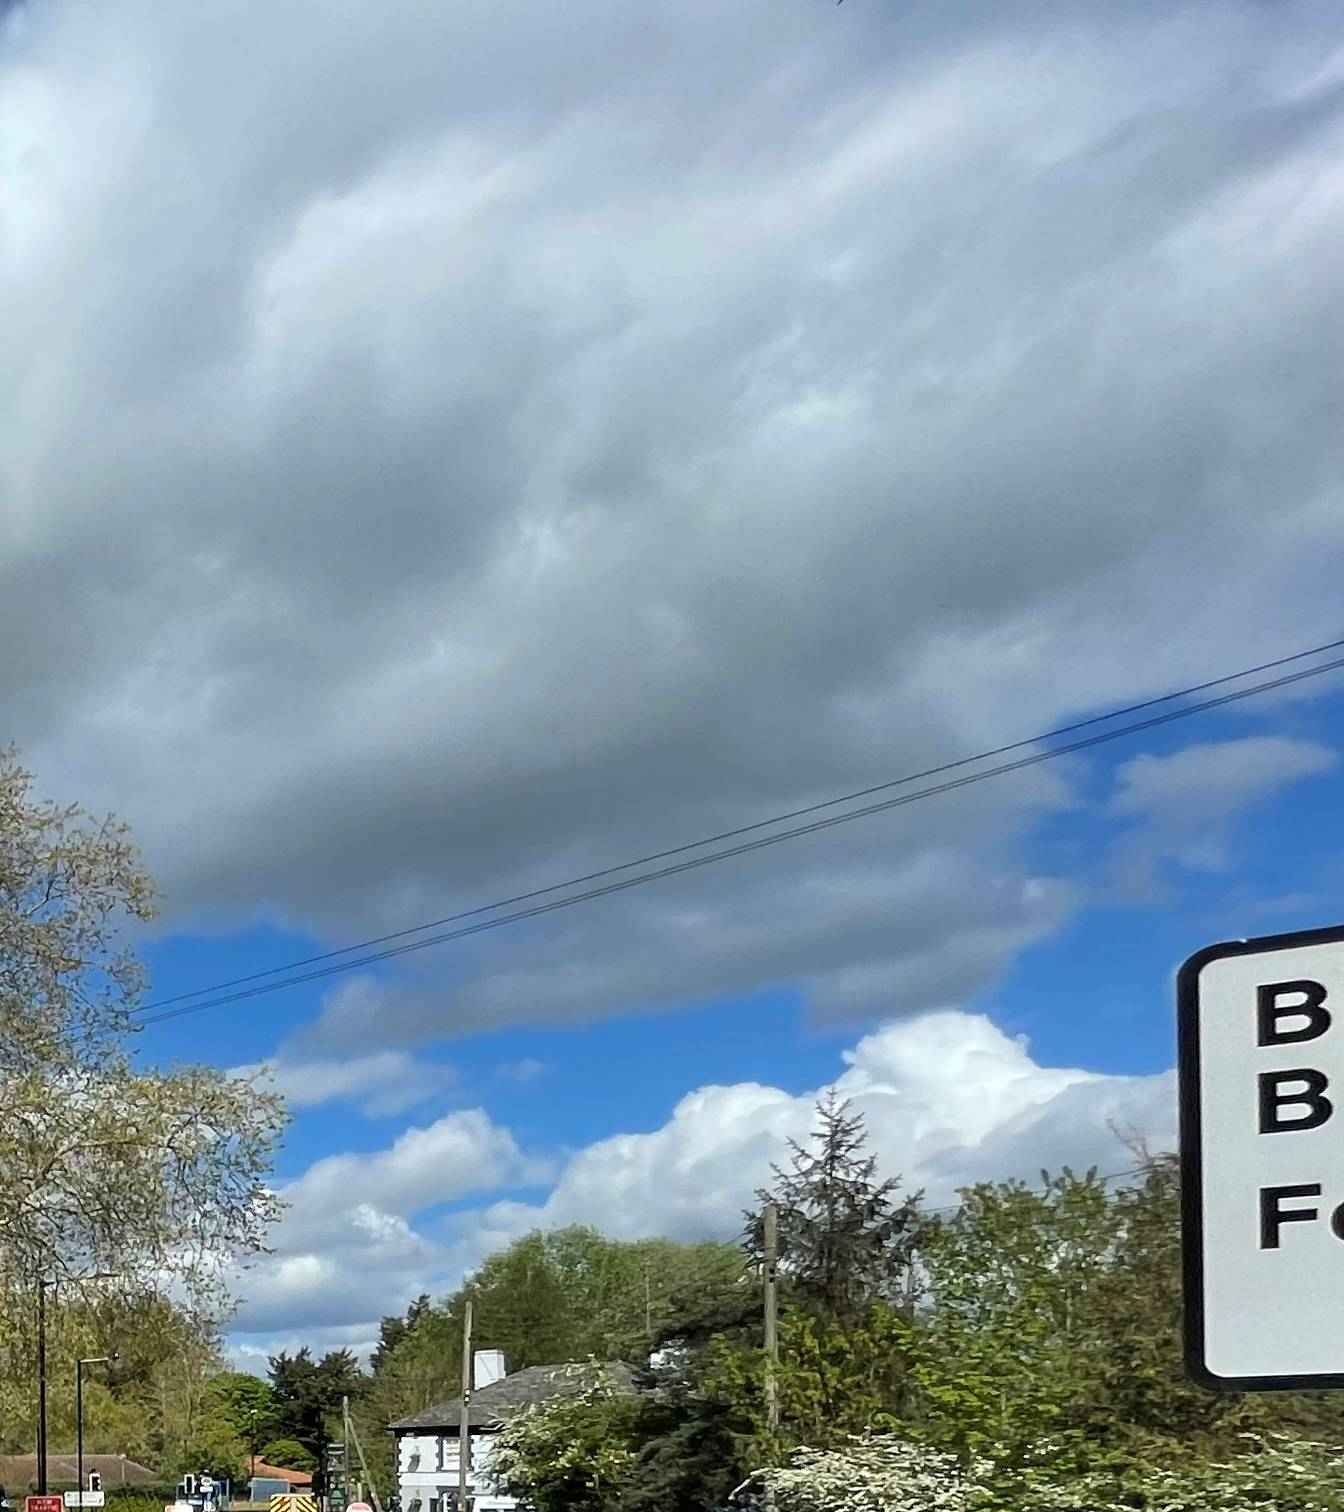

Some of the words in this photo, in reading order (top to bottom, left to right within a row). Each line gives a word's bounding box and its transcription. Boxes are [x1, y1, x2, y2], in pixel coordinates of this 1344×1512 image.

[1257, 980, 1332, 1047] B
[1258, 1068, 1333, 1134] B
[1260, 1183, 1344, 1249] F
